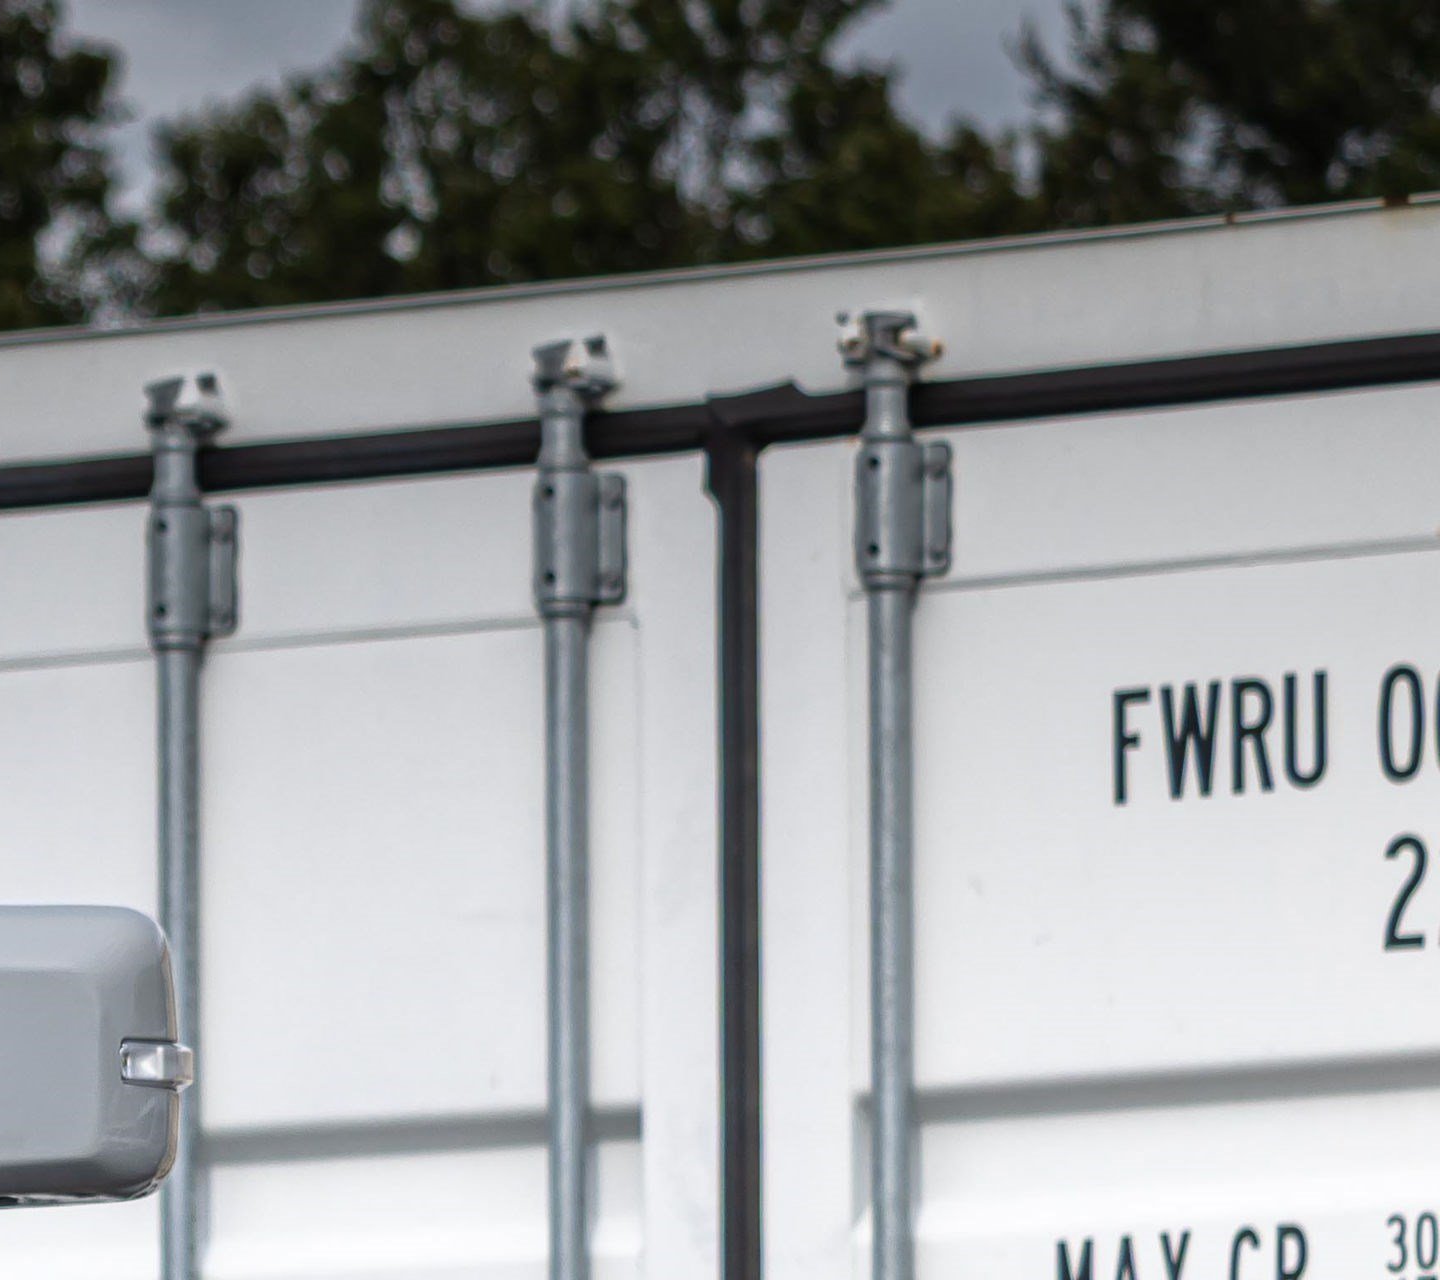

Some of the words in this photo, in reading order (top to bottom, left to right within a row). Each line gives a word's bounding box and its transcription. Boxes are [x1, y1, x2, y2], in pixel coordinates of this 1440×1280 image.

[1112, 668, 1329, 806] FWRU
[1377, 662, 1440, 784] 0
[1383, 832, 1440, 951] 2
